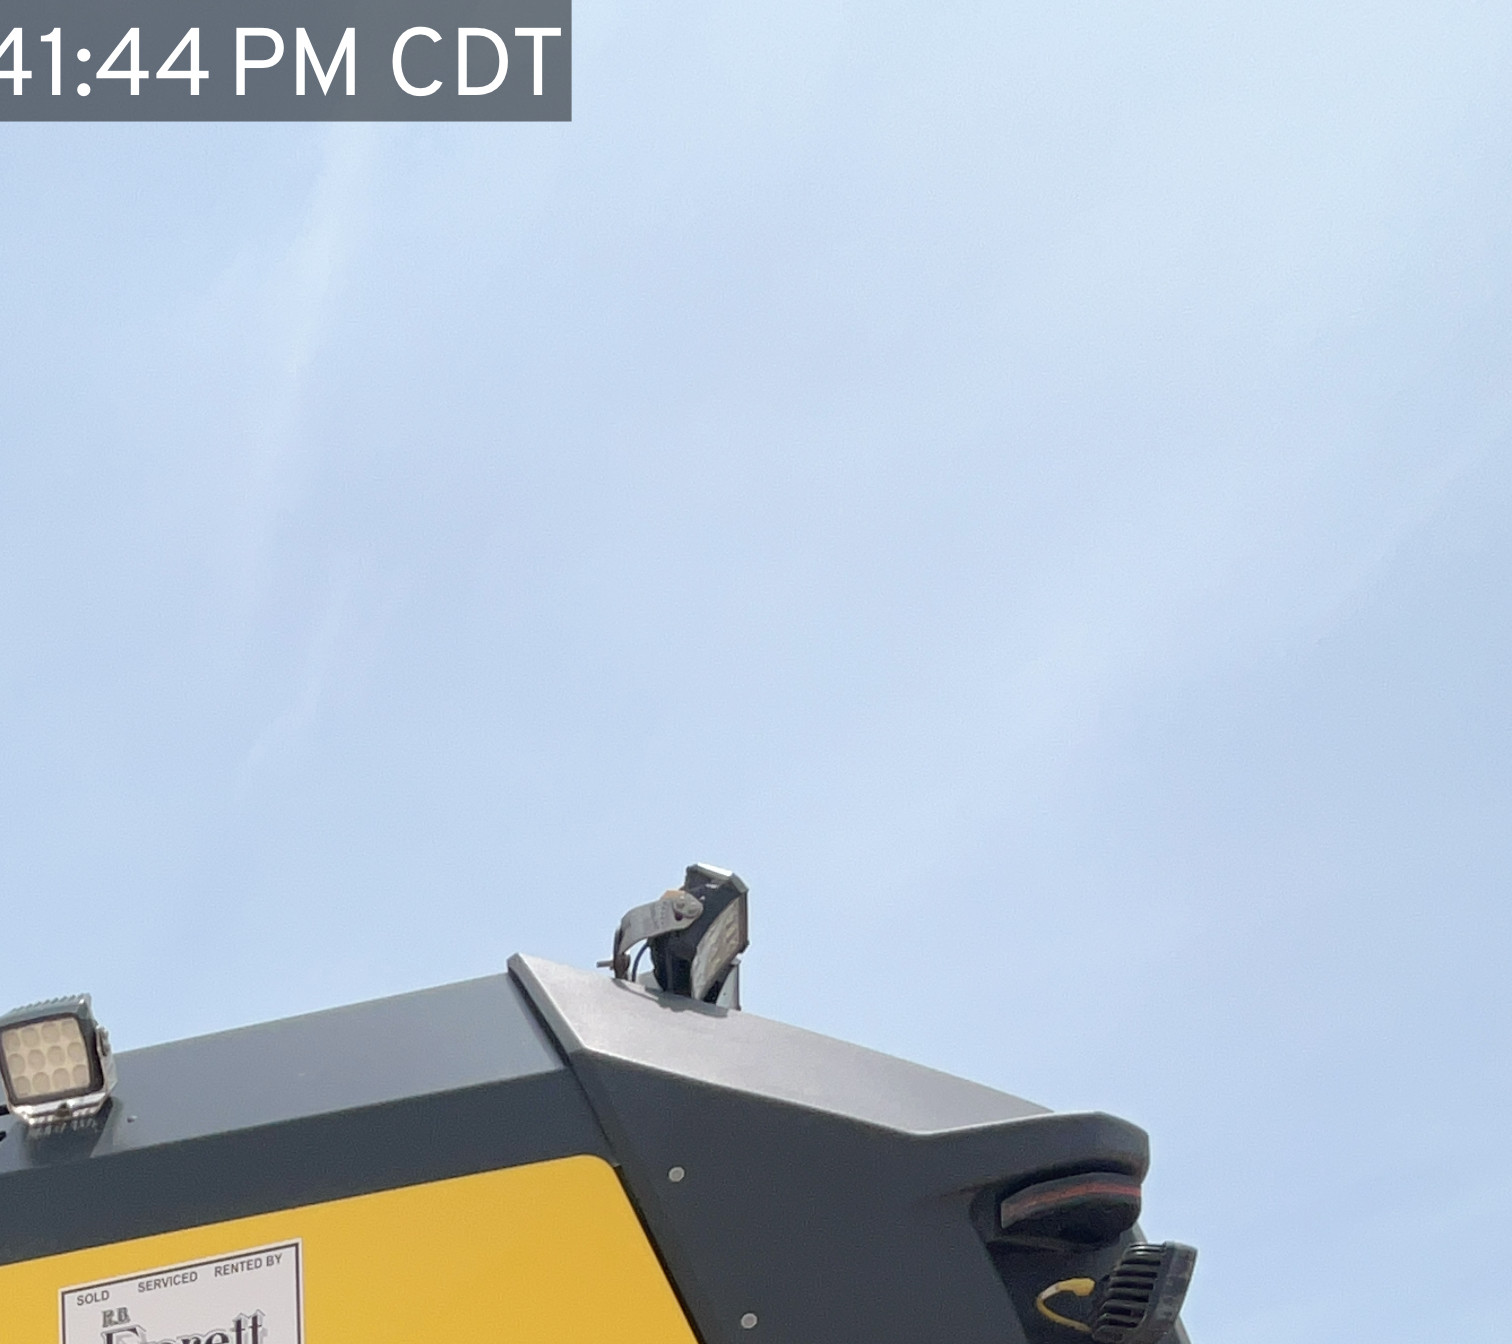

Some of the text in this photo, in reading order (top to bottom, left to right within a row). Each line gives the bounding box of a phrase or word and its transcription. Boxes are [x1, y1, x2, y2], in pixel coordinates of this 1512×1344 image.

[76, 1253, 283, 1306] SOLD SERVICED RENTED BY
